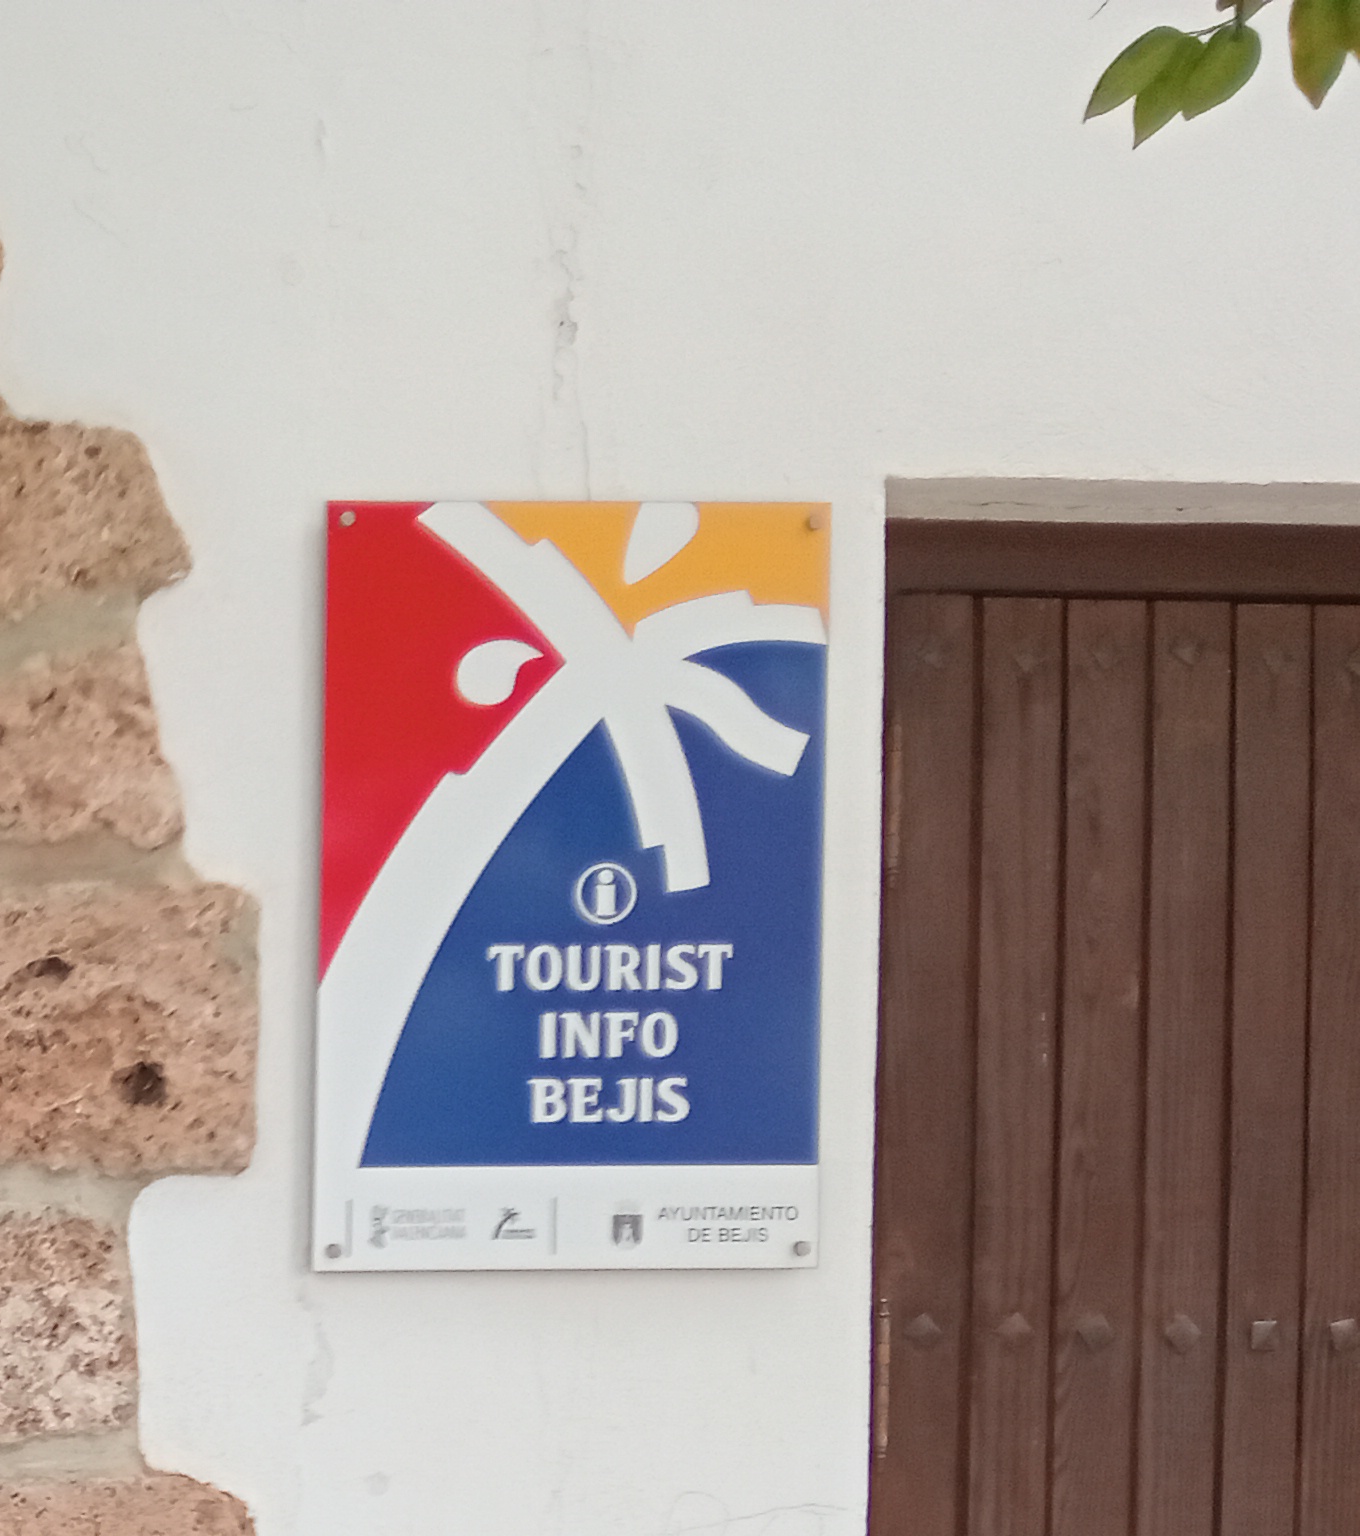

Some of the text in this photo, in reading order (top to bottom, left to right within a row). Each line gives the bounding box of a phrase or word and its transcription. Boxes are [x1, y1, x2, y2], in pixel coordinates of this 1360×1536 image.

[486, 943, 735, 992] TOURIST
[539, 1011, 680, 1059] INFO
[527, 1076, 691, 1124] BEJIS
[657, 1205, 800, 1222] AYUNTAMIENTO
[687, 1227, 770, 1243] DE BEJIS
